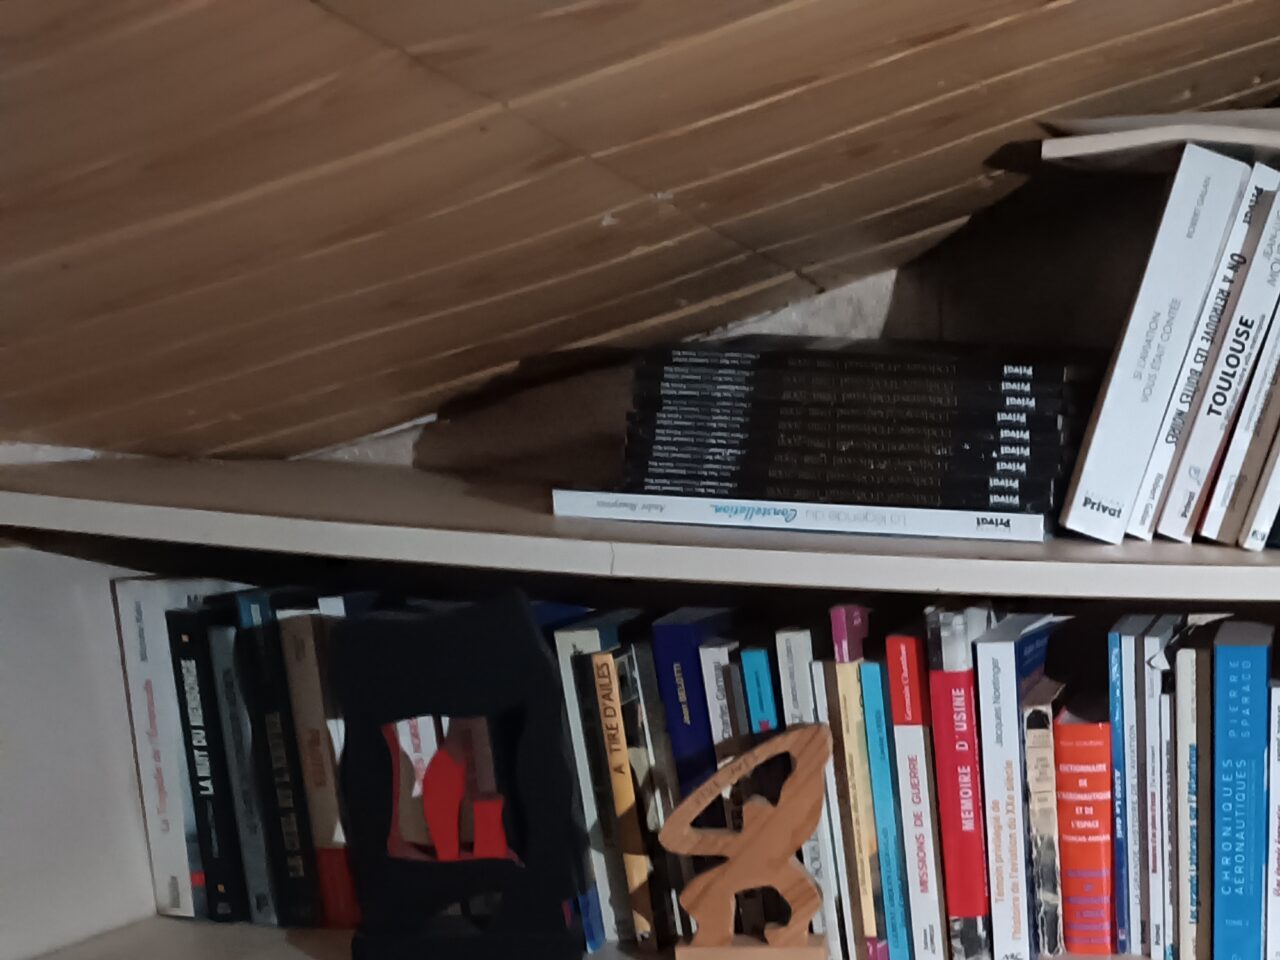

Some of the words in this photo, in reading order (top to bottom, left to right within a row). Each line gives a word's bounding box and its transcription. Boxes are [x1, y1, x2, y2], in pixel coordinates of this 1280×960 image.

[1003, 364, 1032, 375] Privat
[1206, 314, 1254, 419] TOULOUSE
[1000, 381, 1030, 391] Privat
[1006, 396, 1035, 406] Privat
[996, 411, 1026, 422] Privat
[1000, 428, 1029, 439] Privat
[1000, 444, 1029, 455] Privat
[996, 460, 1025, 471] Privat
[988, 477, 1018, 488] Privat
[989, 493, 1018, 504] Privat
[1082, 497, 1123, 518] Privat
[976, 516, 1010, 530] Privat
[597, 661, 617, 718] D'AILES
[1228, 660, 1238, 736] PIERRE
[1241, 660, 1251, 737] SPARACO
[606, 720, 622, 753] TIRE
[992, 706, 1005, 747] Jacques
[191, 727, 206, 747] DU
[1128, 724, 1136, 779] L'AVIATION
[194, 747, 211, 777] NUIT
[199, 779, 213, 795] LA
[907, 754, 921, 804] GUERRE
[1130, 782, 1137, 795] DE
[957, 764, 974, 831] MEMOIRE
[912, 811, 923, 827] DE
[1131, 800, 1139, 845] HISTOIRE
[1221, 759, 1232, 894] CHRONIQUES
[914, 833, 930, 893] MISSIONS
[1134, 893, 1141, 905] LA
